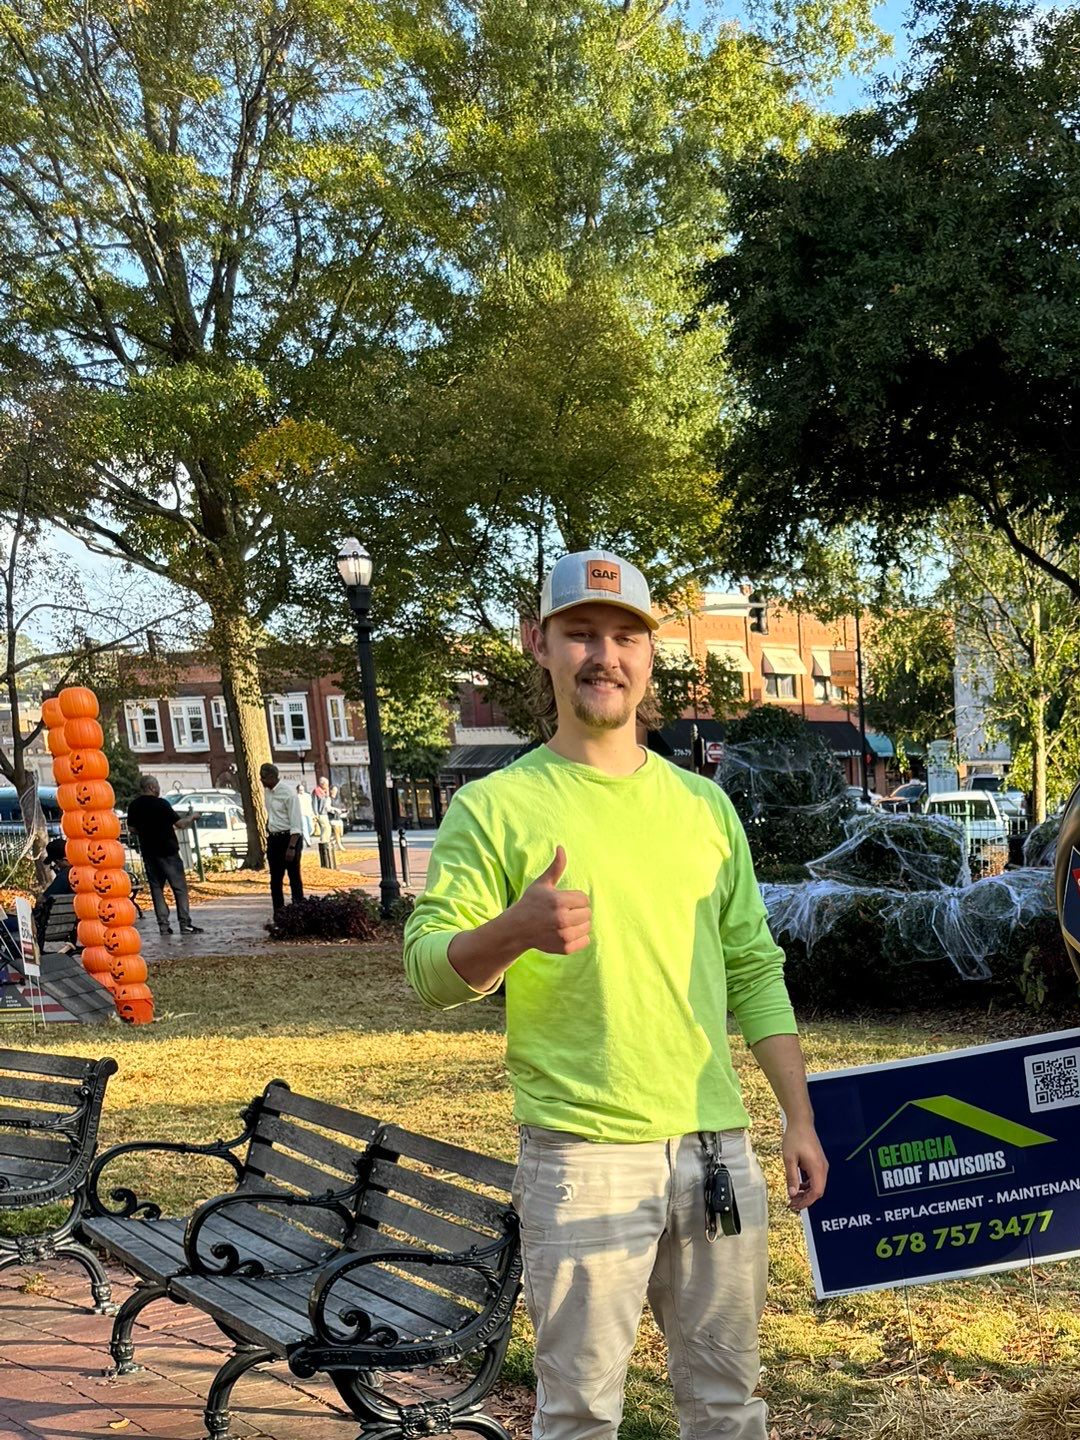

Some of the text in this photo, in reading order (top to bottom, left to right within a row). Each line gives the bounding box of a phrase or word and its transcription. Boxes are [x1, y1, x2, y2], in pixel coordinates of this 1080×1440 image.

[592, 569, 617, 580] GAF
[878, 1135, 957, 1168] GEORGIA
[882, 1150, 1006, 1189] ROOF ADVISORS
[821, 1214, 872, 1232] REPAIR
[885, 1195, 984, 1222] REPLACEMENT
[875, 1209, 1054, 1259] 678 757 3477
[476, 1295, 511, 1339] GLOVER
